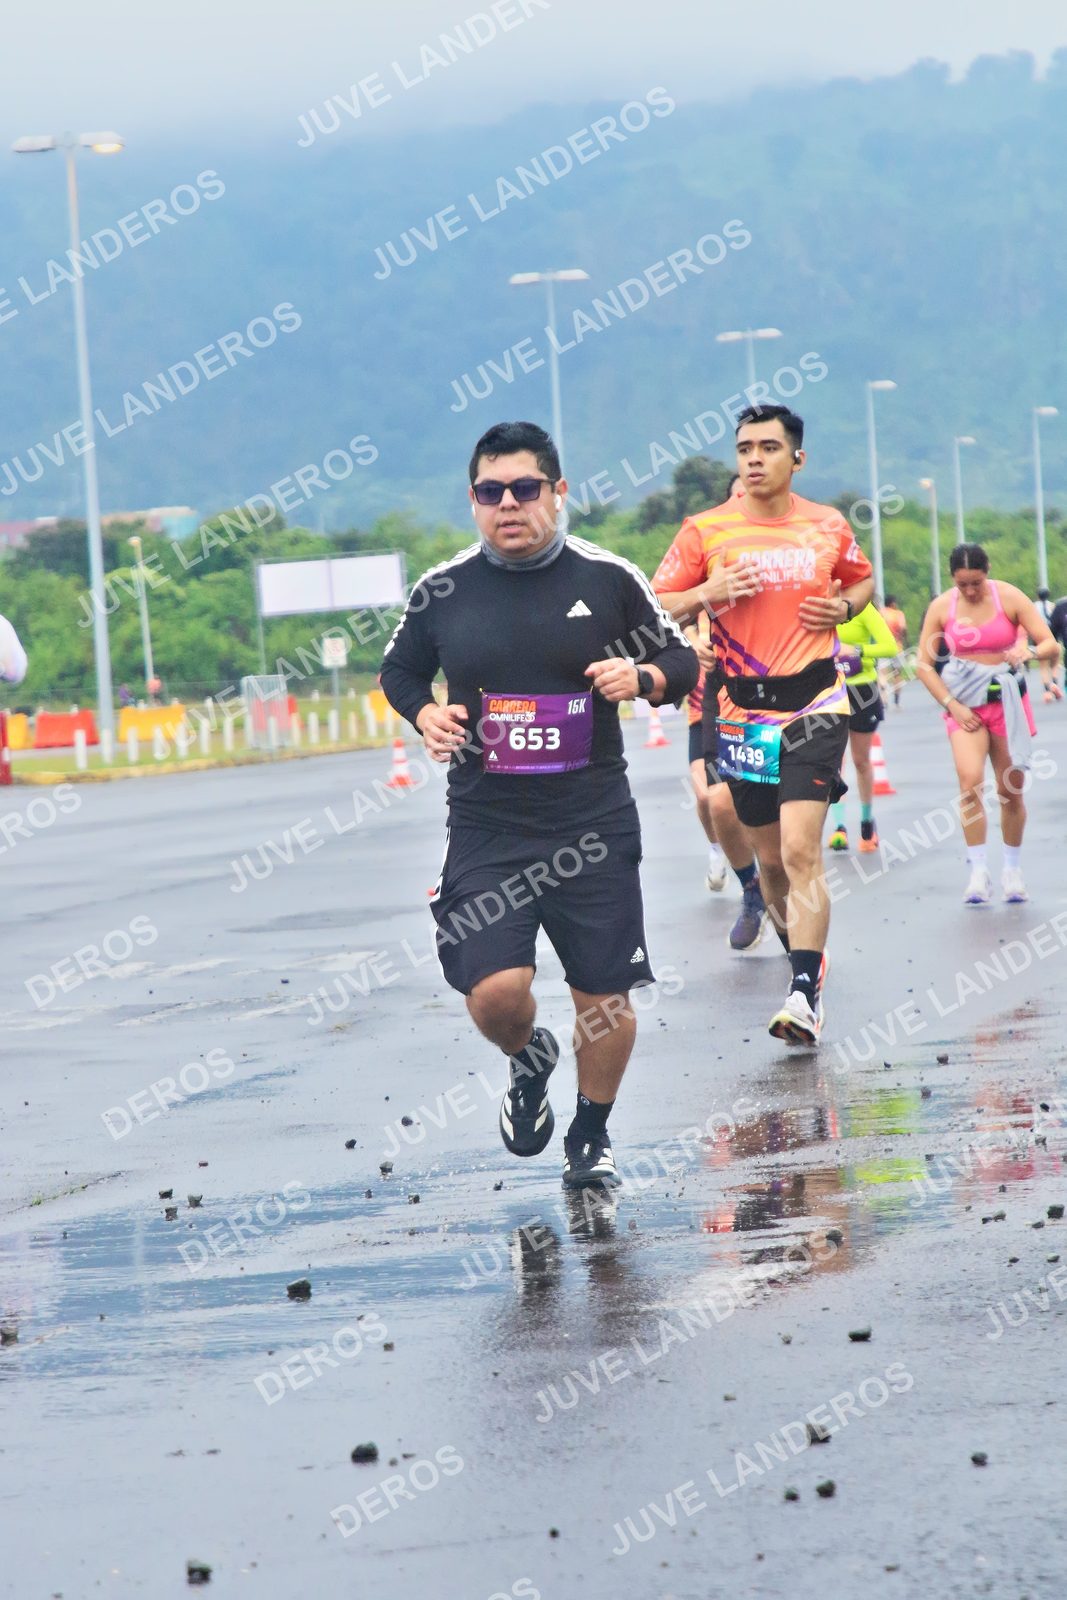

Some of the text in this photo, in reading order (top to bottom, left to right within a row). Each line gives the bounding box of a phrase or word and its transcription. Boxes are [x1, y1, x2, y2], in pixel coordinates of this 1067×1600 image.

[489, 699, 537, 713] CARRERA
[509, 728, 561, 751] 653
[728, 745, 764, 766] 1439
